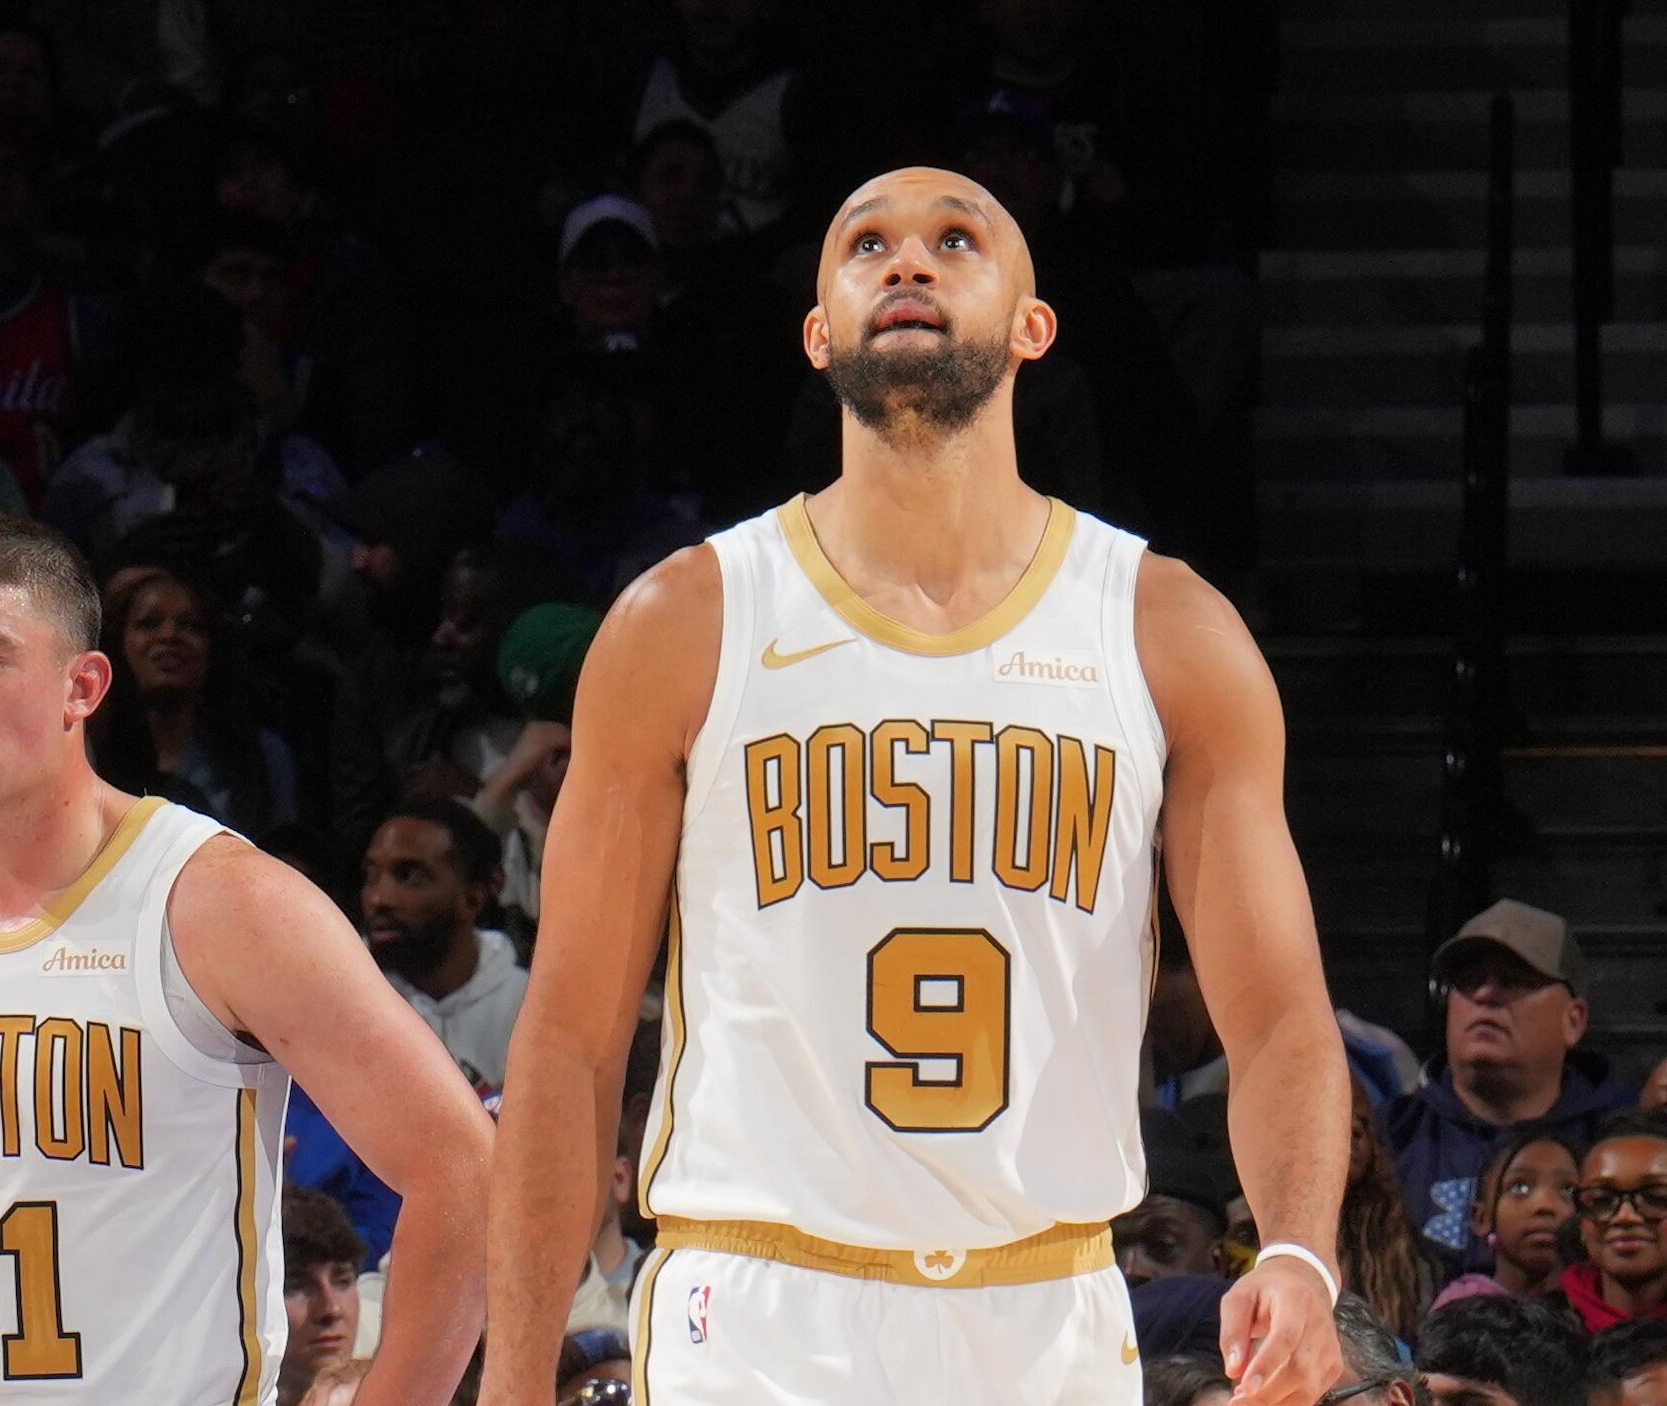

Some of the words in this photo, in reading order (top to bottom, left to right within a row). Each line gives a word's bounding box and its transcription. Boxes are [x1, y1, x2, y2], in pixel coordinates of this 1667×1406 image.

[998, 651, 1100, 683] Amica
[744, 719, 1116, 914] BOSTON
[42, 946, 128, 972] Amica
[865, 928, 1012, 1133] 9
